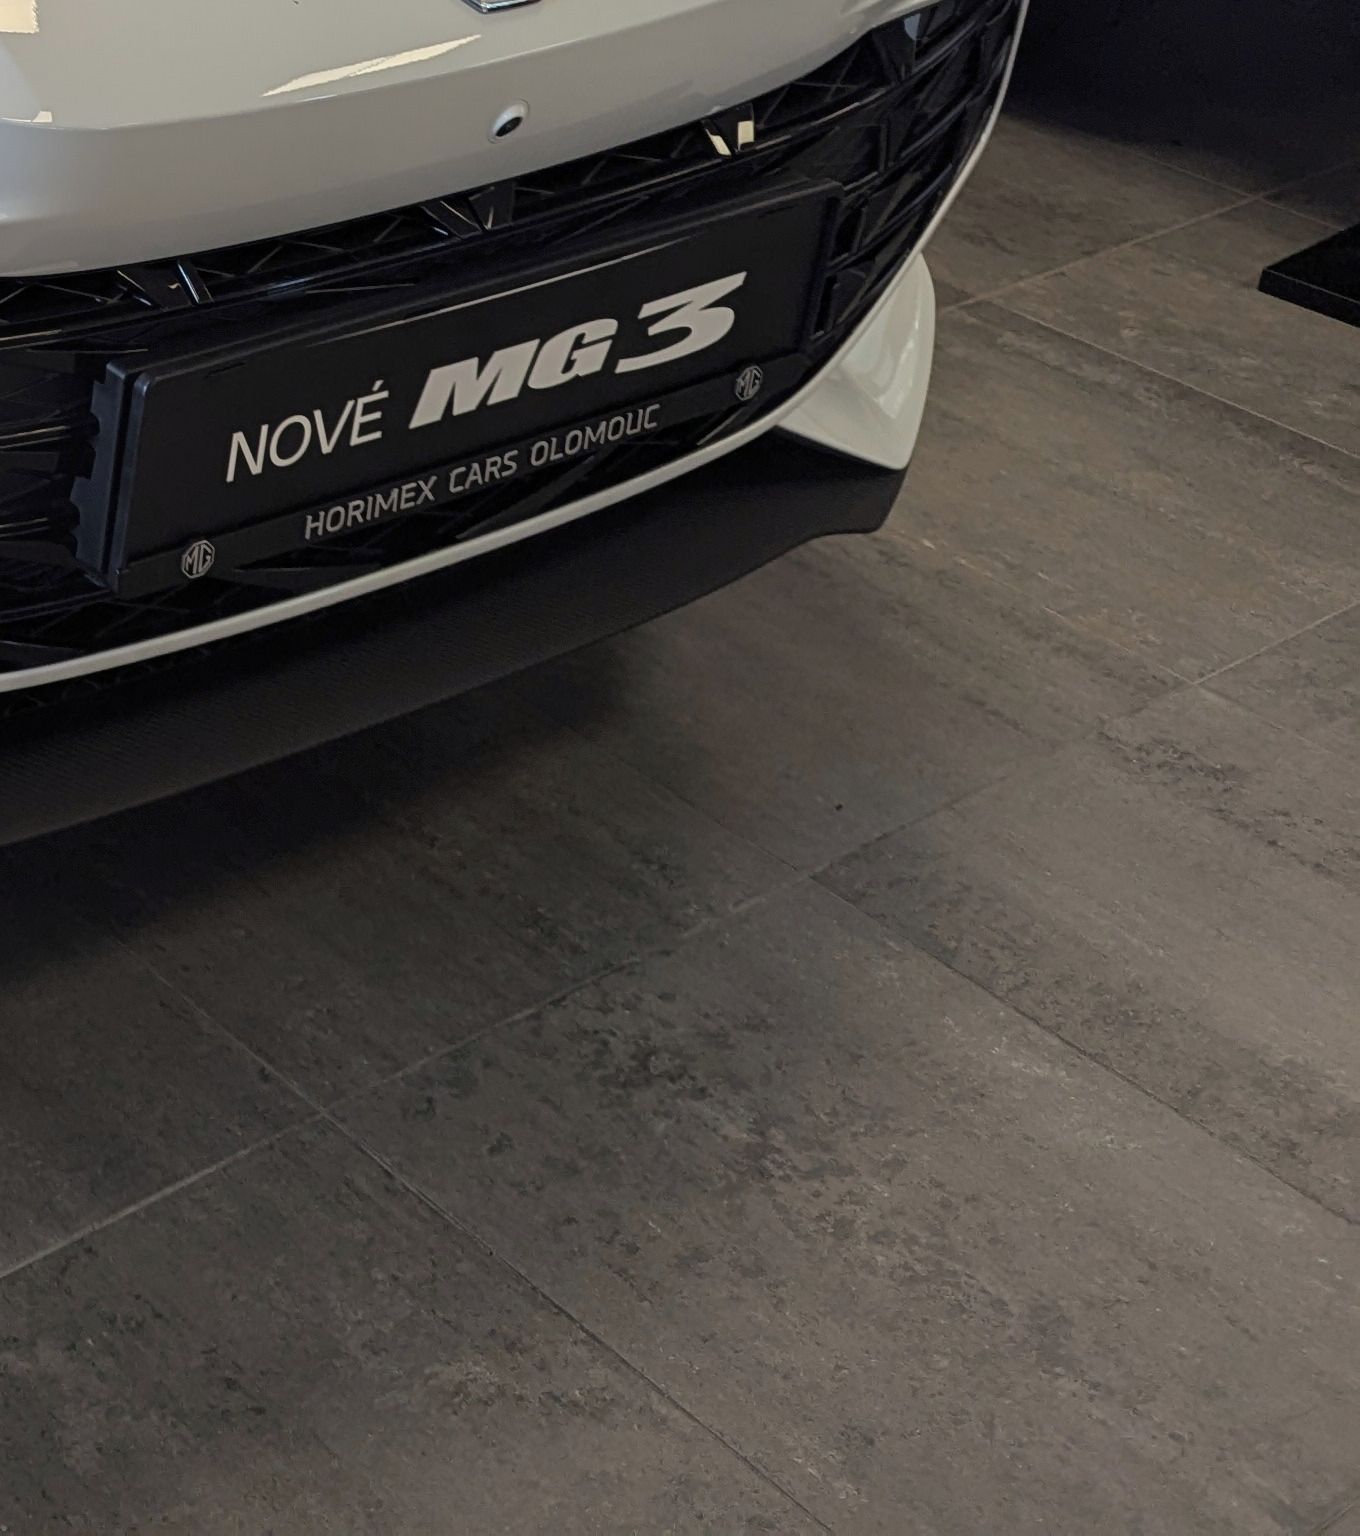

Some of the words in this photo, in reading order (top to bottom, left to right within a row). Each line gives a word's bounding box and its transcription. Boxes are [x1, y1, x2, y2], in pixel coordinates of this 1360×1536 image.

[736, 365, 762, 400] MG
[225, 378, 389, 483] NOVÉ
[304, 475, 438, 541] HORIMEX
[449, 449, 519, 494] CARS
[530, 404, 660, 467] OLOMOUC
[183, 542, 214, 577] MG
